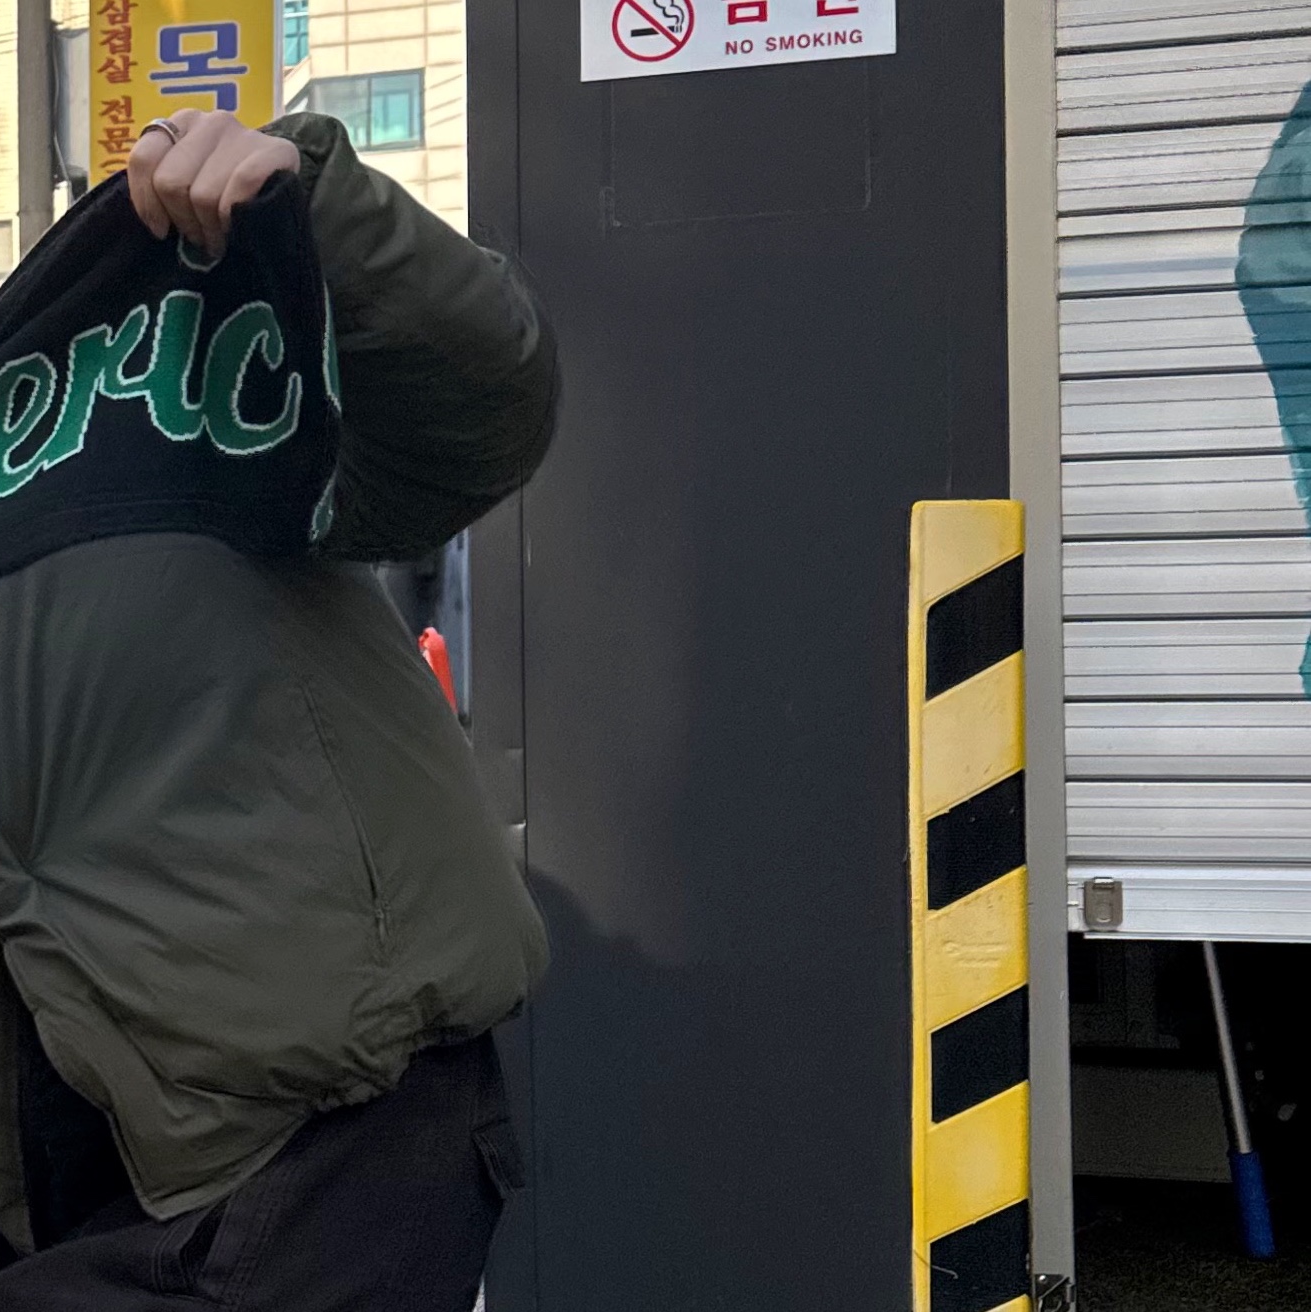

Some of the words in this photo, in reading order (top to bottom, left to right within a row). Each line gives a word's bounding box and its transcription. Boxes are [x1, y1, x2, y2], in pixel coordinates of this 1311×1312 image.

[97, 0, 139, 83] 삼겹살
[725, 40, 753, 55] NO
[766, 29, 863, 51] SMOKING
